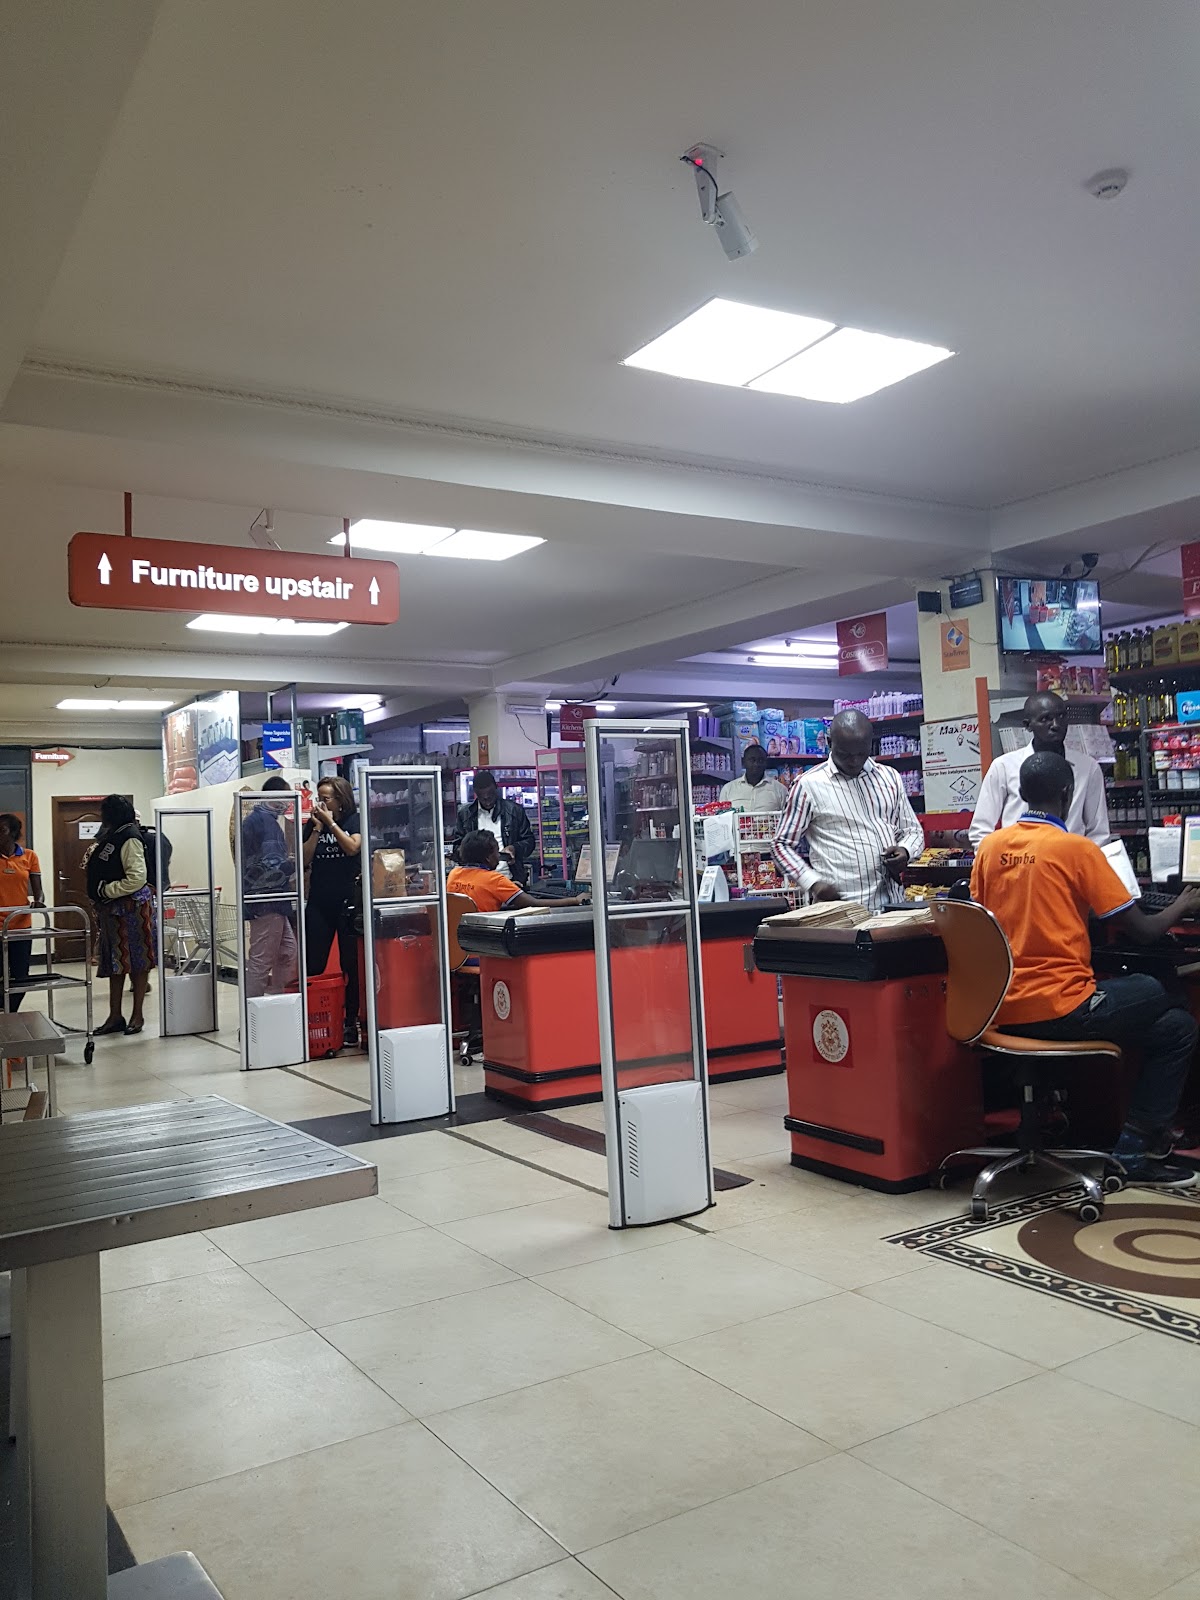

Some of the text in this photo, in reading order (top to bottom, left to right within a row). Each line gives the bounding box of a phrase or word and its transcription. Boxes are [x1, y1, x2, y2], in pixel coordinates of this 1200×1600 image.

[132, 559, 354, 600] Furniture upstair
[35, 752, 69, 760] Furniture
[952, 795, 975, 803] EWSA
[1000, 852, 1036, 866] Simba
